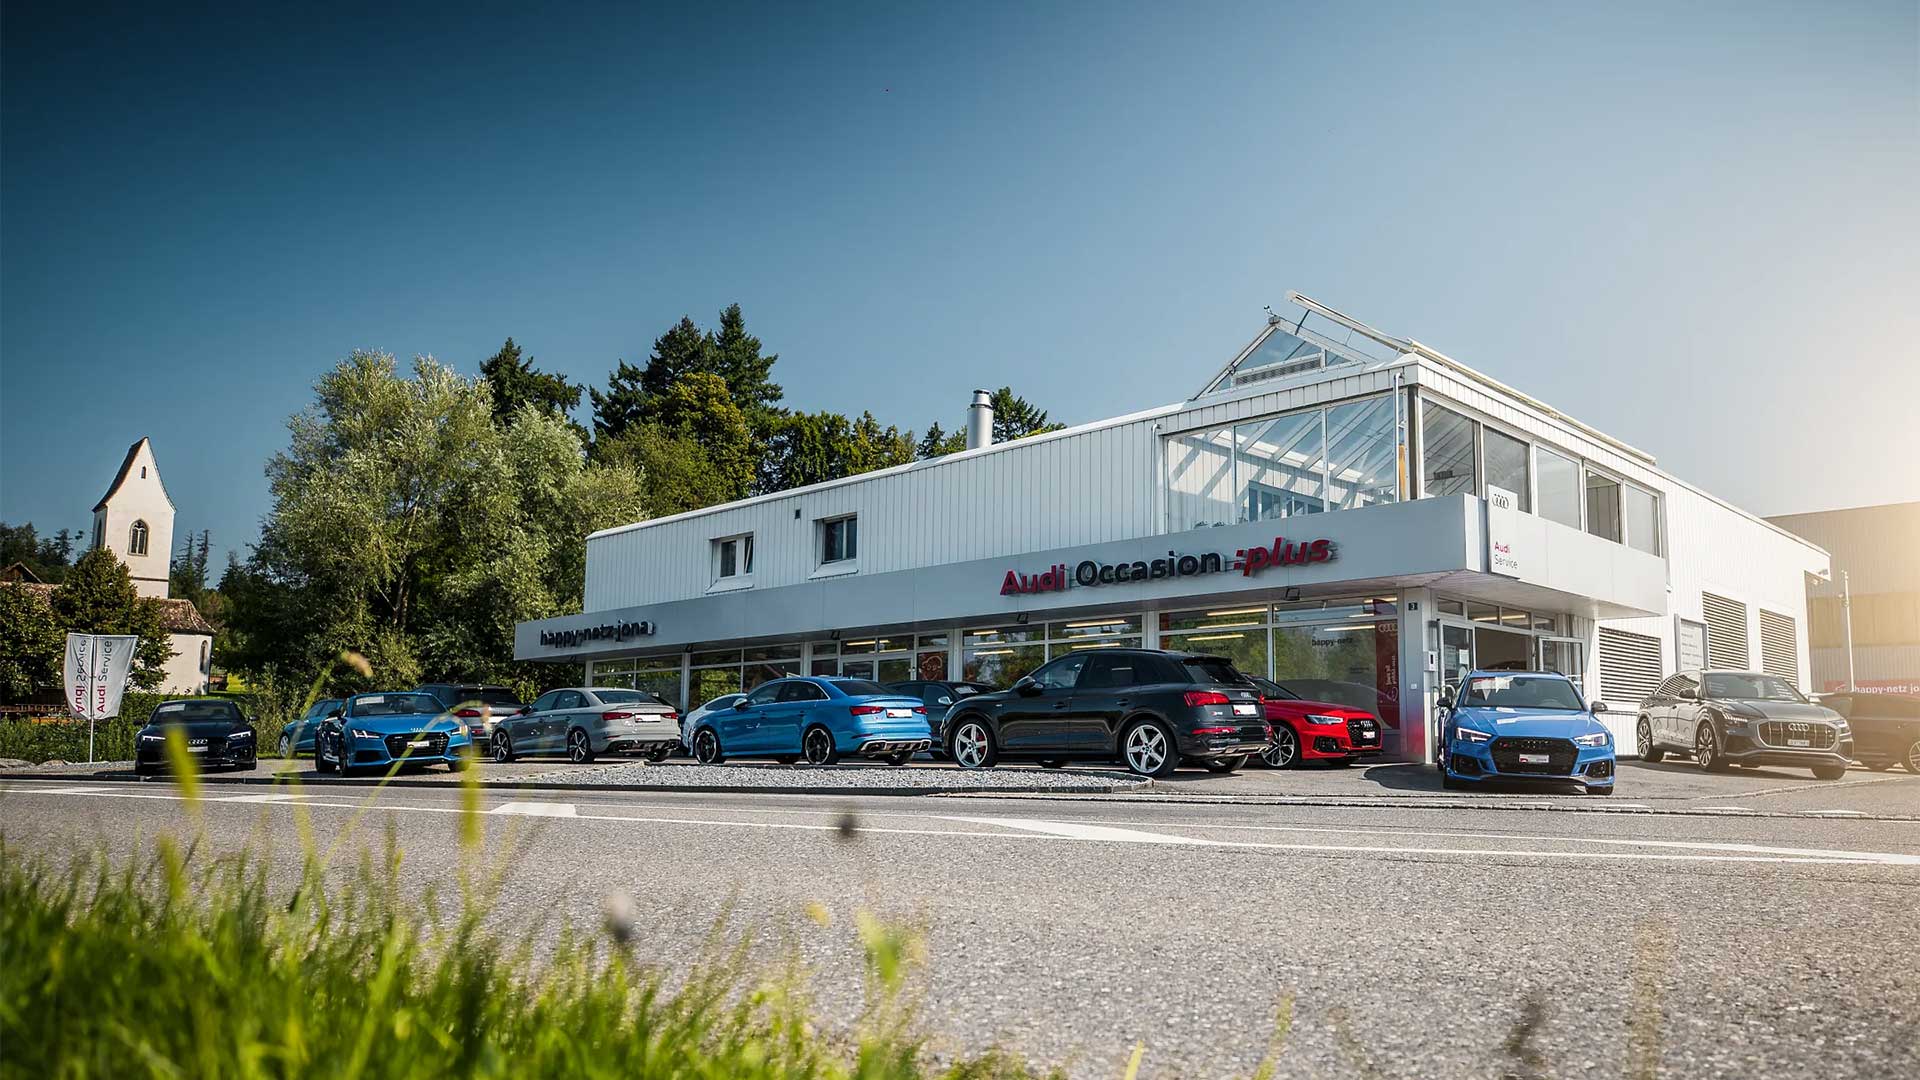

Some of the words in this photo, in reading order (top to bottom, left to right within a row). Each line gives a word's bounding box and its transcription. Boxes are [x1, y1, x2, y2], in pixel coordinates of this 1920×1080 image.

[1494, 541, 1511, 554] Audi
[1000, 563, 1066, 595] Audi
[1075, 550, 1223, 587] Occasion
[98, 640, 113, 682] Service
[96, 685, 106, 713] Audi
